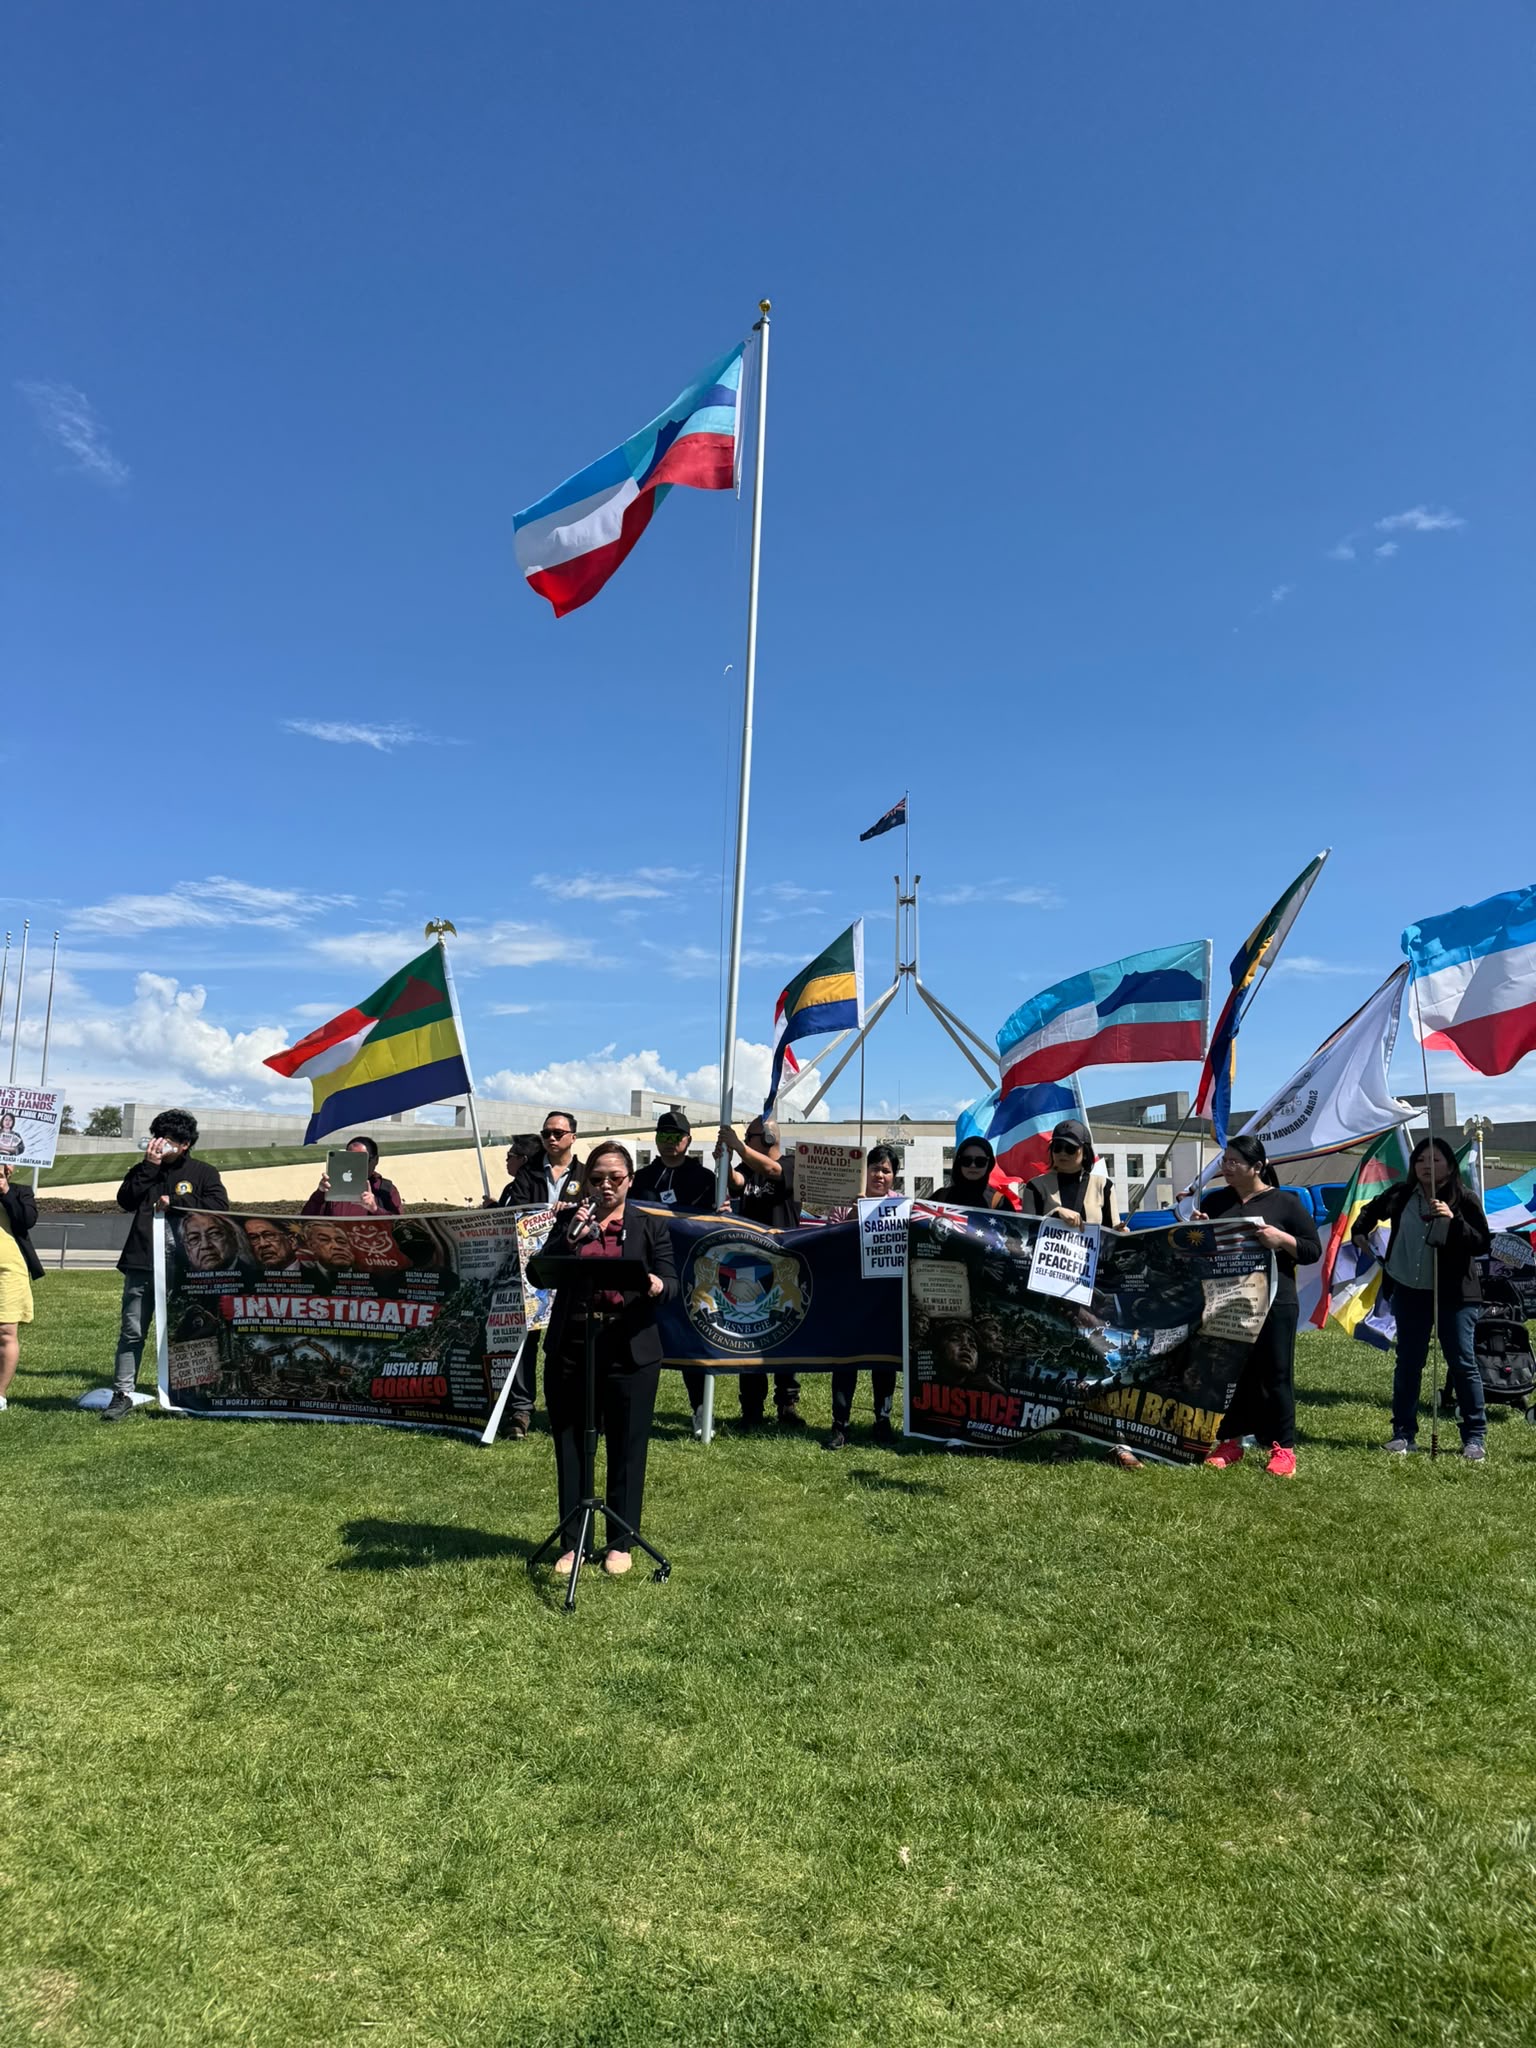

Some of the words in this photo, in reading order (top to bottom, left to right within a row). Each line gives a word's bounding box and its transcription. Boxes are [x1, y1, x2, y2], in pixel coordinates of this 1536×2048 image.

[18, 1091, 57, 1102] FUTURE
[17, 1100, 55, 1111] HANDS.
[813, 1146, 844, 1157] MA63
[807, 1155, 851, 1167] INVALID!
[878, 1206, 898, 1217] LET
[444, 1217, 464, 1226] FROM
[465, 1213, 491, 1223] BRITISH
[864, 1218, 909, 1232] SABAHAN
[466, 1227, 500, 1237] POLITICAL
[528, 1223, 547, 1234] DALAM
[727, 1232, 749, 1240] SABAH
[749, 1234, 772, 1248] NORTH
[873, 1232, 907, 1244] DECIDE
[1042, 1226, 1097, 1251] AUSTRALIA,
[865, 1245, 892, 1256] THEIR
[1044, 1241, 1072, 1256] STAND
[1073, 1250, 1090, 1263] FOR
[365, 1258, 398, 1267] UMNO
[1038, 1252, 1092, 1278] PEACEFUL
[1035, 1266, 1091, 1288] SELF-DETERMINATION
[495, 1291, 521, 1304] MALAYA
[233, 1296, 435, 1326] INVESTIGATE
[488, 1312, 526, 1327] MALAYSI
[501, 1327, 522, 1335] ILLEGAL
[723, 1320, 751, 1333] RSNB
[753, 1320, 771, 1331] GIE
[493, 1335, 519, 1344] COUNTRY
[697, 1319, 756, 1349] GOVERNMENT
[759, 1337, 771, 1346] IN
[773, 1319, 796, 1340] EXILE
[190, 1349, 207, 1357] LAND
[1070, 1348, 1098, 1361] SABAH
[381, 1361, 419, 1376] JUSTICE
[420, 1361, 438, 1375] FOR
[176, 1378, 192, 1388] NOT
[371, 1375, 448, 1398] BORNEO
[269, 1399, 288, 1407] KNOW
[300, 1401, 338, 1410] INDEPENDENT
[338, 1403, 379, 1413] INVESTIGATION
[379, 1406, 392, 1415] NOW
[405, 1409, 430, 1418] JUSTICE
[431, 1411, 444, 1419] FOR
[912, 1381, 1022, 1427] JUSTICE
[967, 1420, 994, 1433] CRIMES
[995, 1425, 1028, 1438] AGAIN
[1082, 1411, 1113, 1427] CANNOT
[1115, 1418, 1126, 1428] BE
[1126, 1421, 1178, 1446] FORGOTTEN
[1152, 1441, 1172, 1452] SABAH
